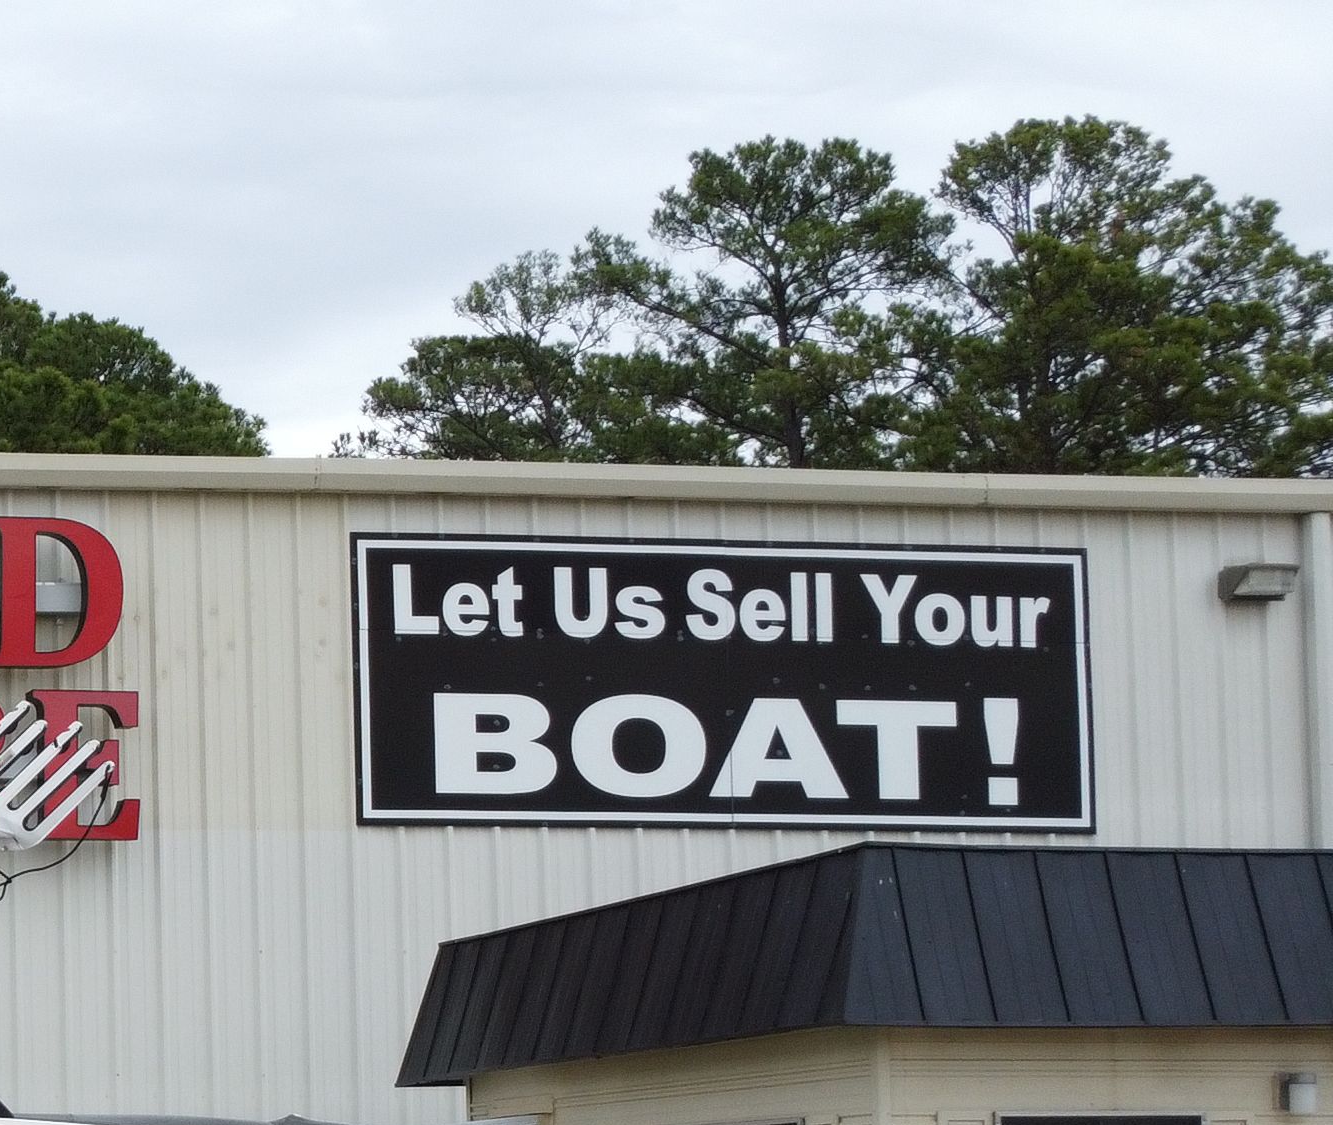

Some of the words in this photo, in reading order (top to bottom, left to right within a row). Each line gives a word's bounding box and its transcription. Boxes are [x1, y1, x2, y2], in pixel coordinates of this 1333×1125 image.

[392, 563, 525, 638] Let
[553, 566, 666, 641] Us
[685, 568, 834, 644] Sell
[859, 573, 1051, 649] Your
[433, 692, 1020, 806] BOAT!
